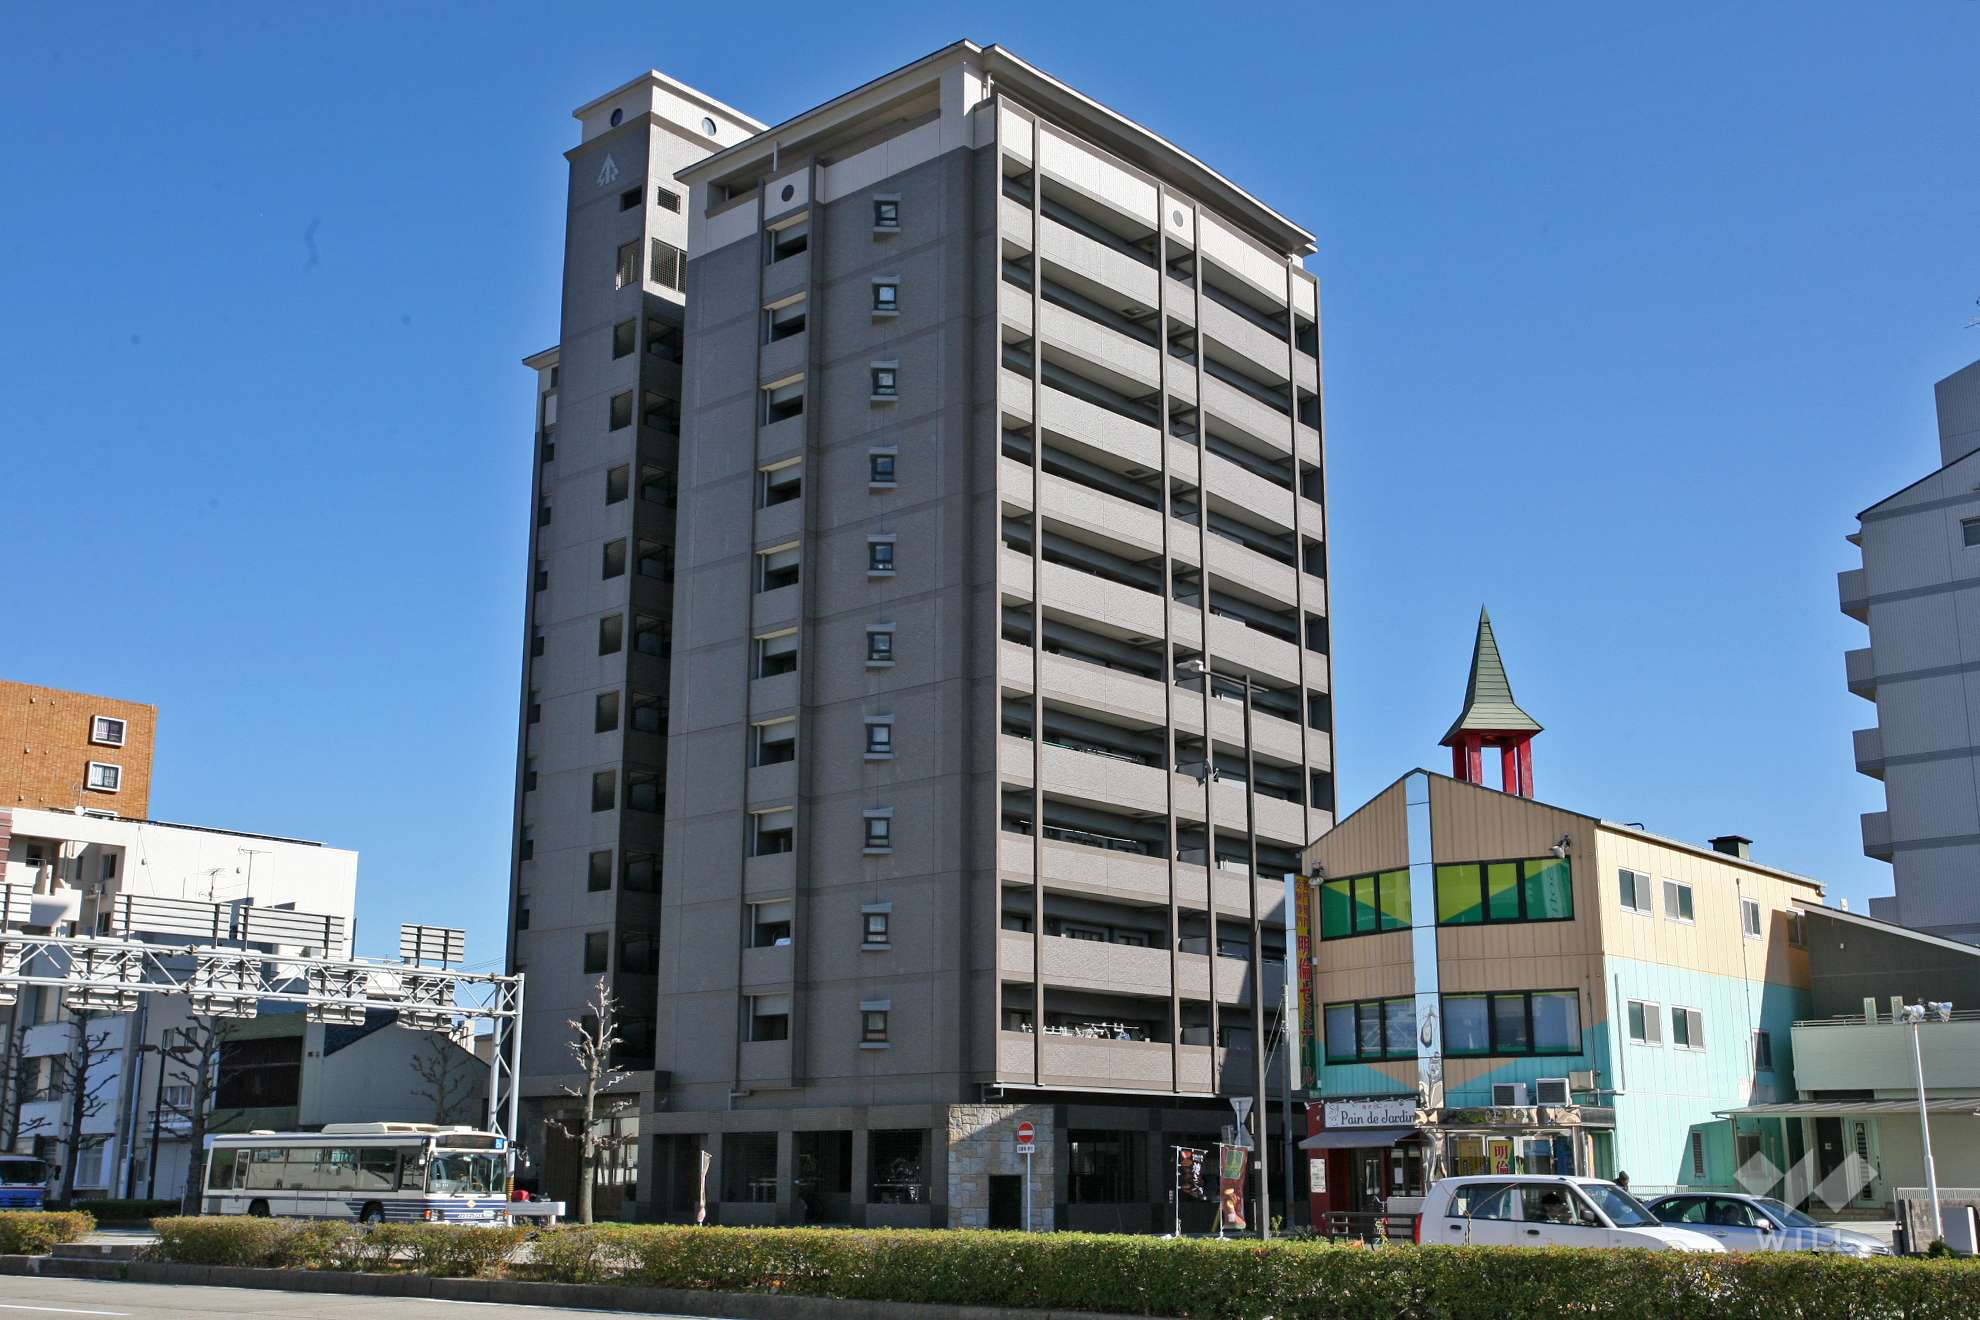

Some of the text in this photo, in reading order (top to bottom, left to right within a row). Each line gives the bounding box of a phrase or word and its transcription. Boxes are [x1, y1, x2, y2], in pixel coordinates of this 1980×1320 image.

[1340, 1109, 1415, 1125] Pain de Jardin
